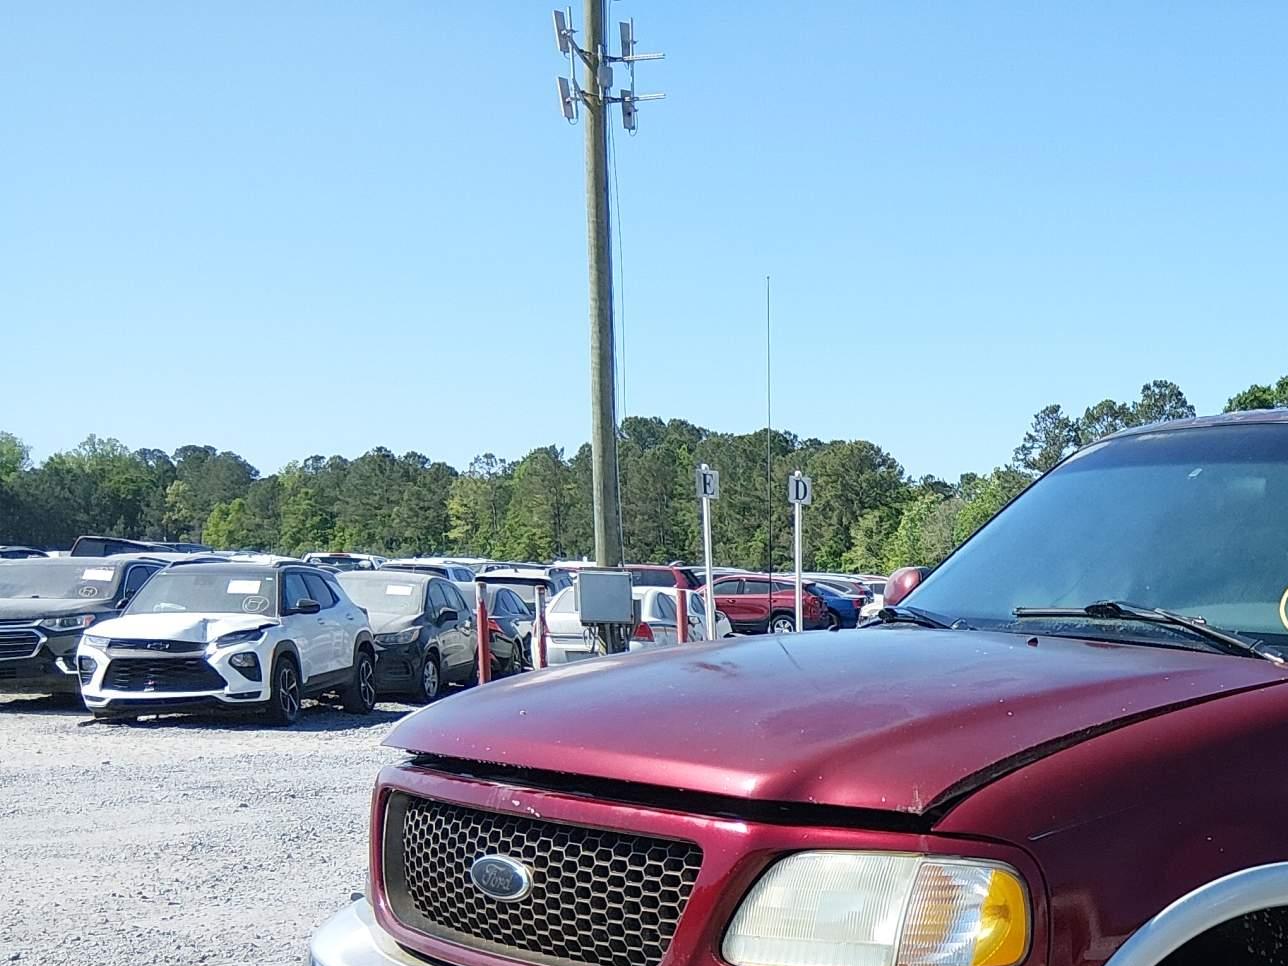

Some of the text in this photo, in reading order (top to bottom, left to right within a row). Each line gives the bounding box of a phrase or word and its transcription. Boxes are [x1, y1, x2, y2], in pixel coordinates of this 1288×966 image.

[702, 473, 715, 496] E
[794, 479, 808, 501] D
[481, 863, 512, 891] Ford
